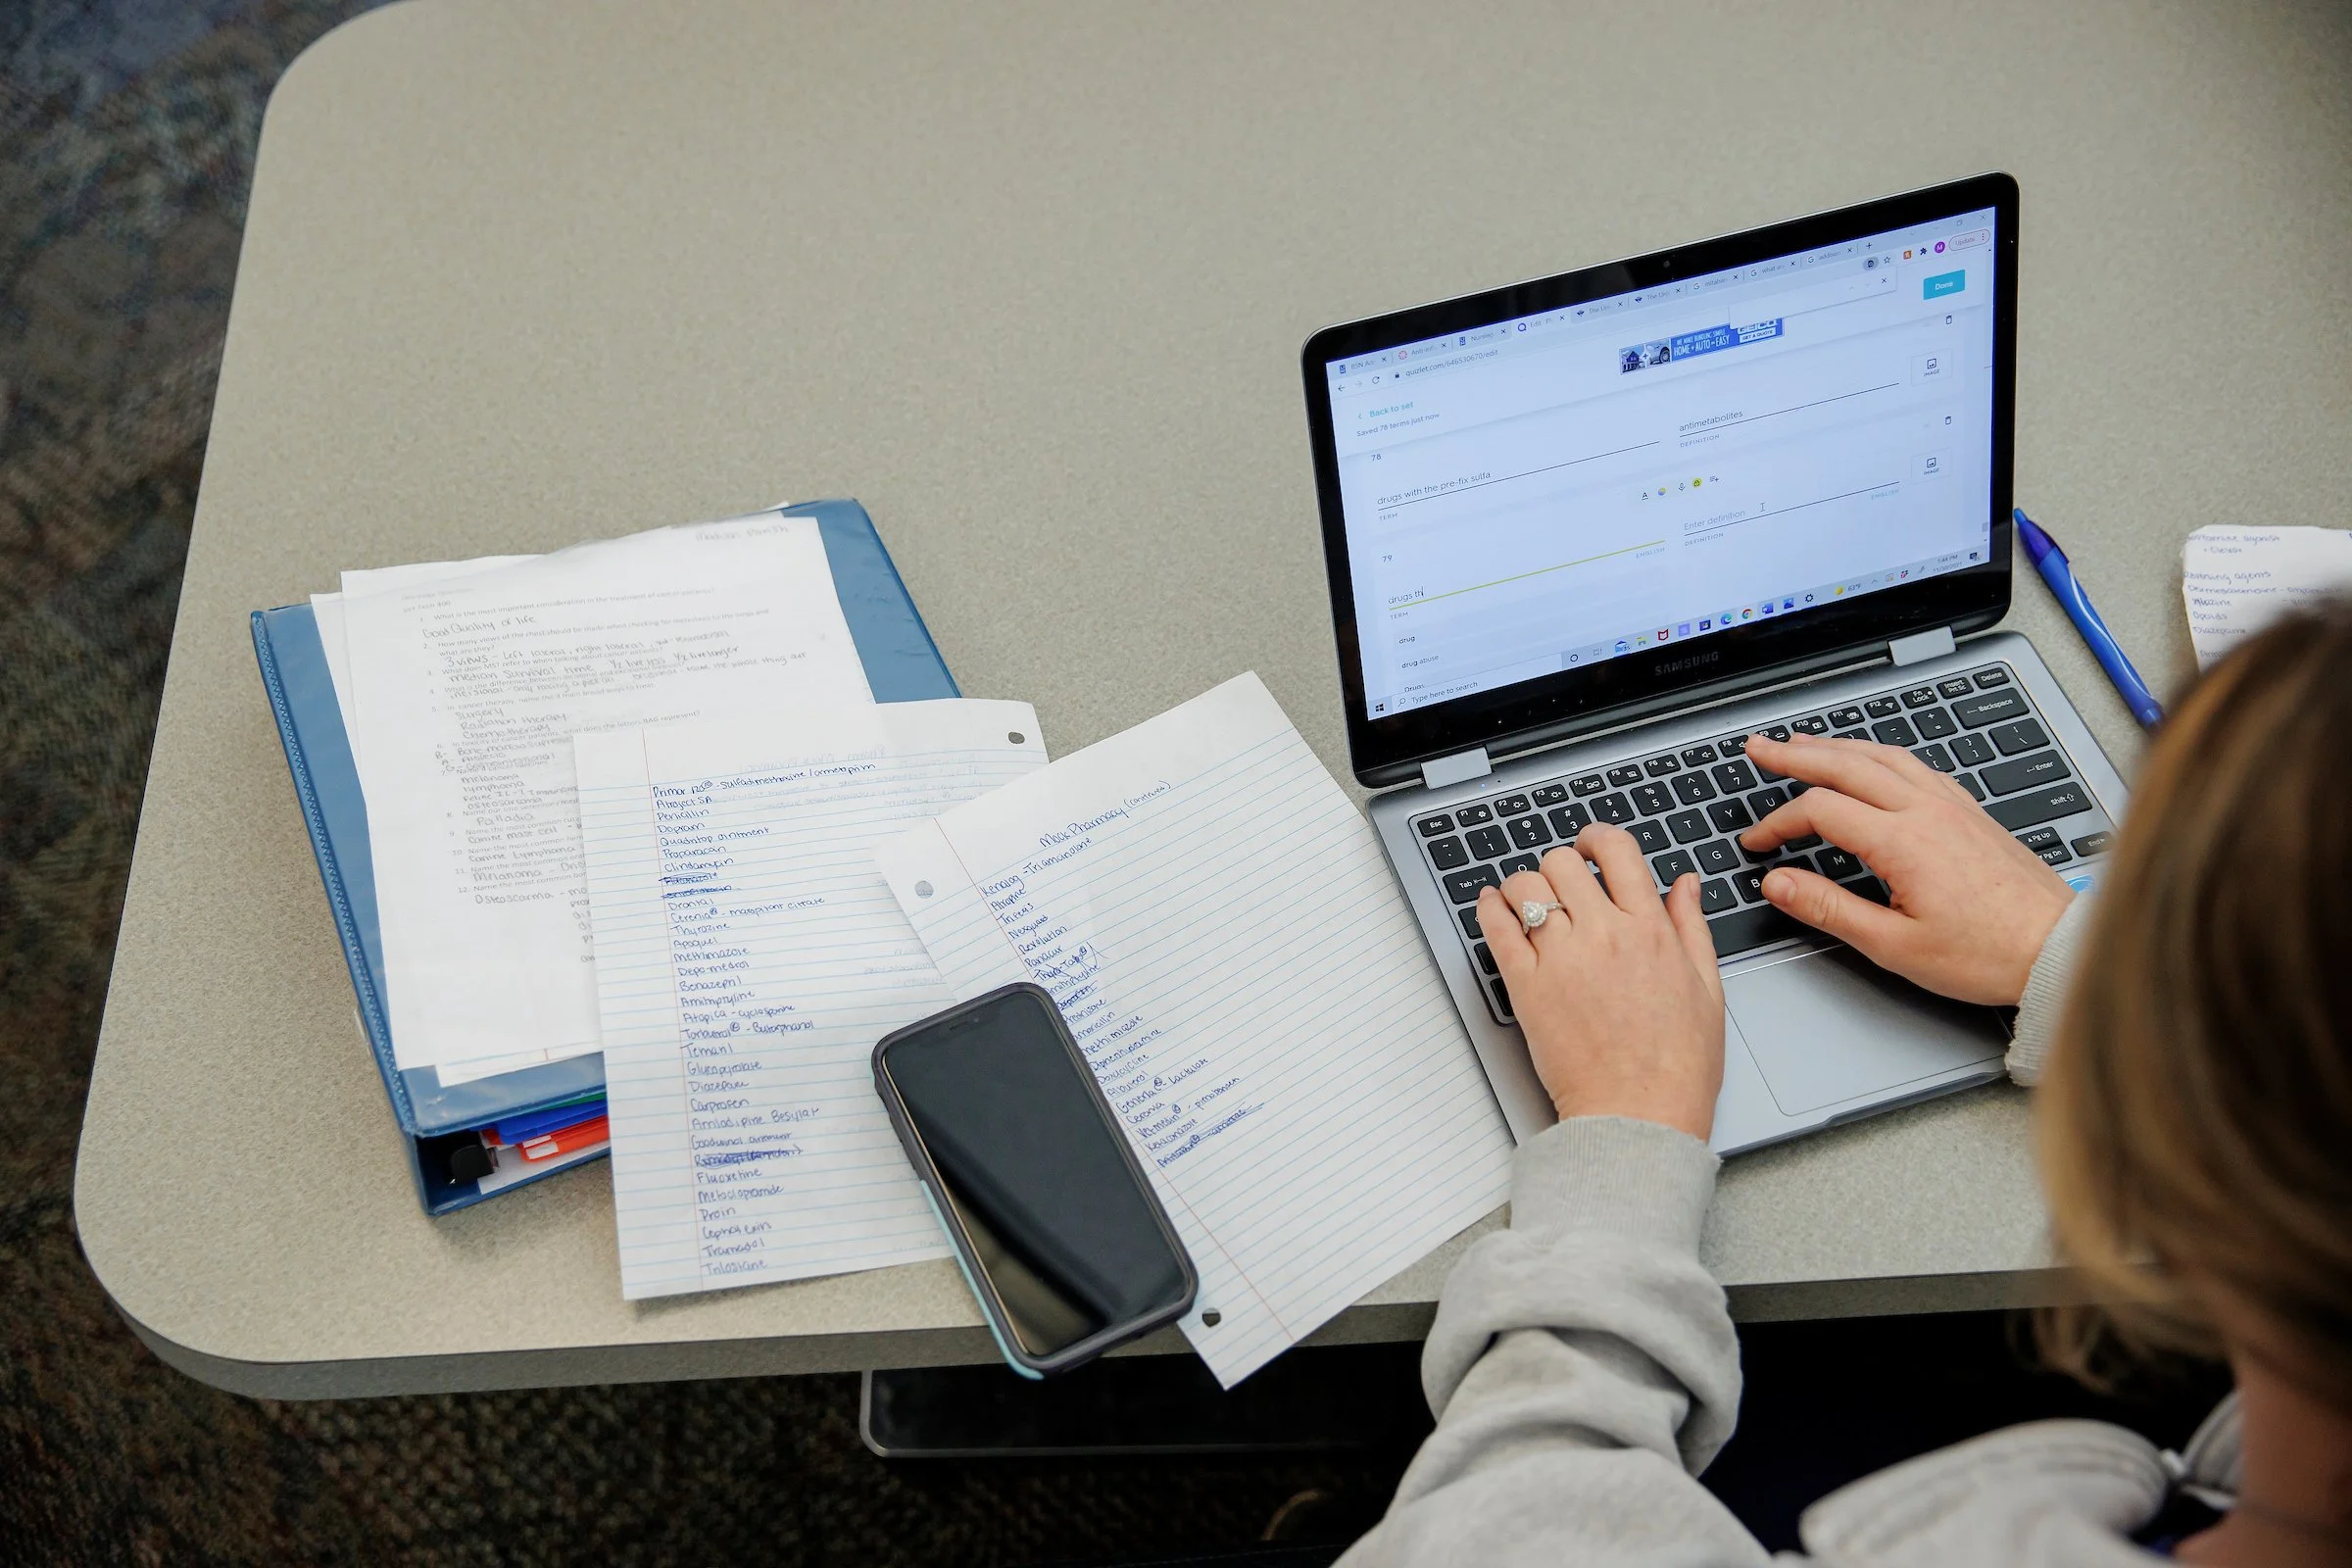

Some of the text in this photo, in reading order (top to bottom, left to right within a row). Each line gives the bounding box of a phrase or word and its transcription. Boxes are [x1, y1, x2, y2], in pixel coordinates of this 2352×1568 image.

[1935, 279, 1953, 290] Done
[1673, 335, 1730, 358] HOME AUTO EASY
[1369, 402, 1414, 418] Back to set
[1356, 425, 1379, 437] Saved
[1390, 420, 1410, 430] terms
[1410, 416, 1424, 428] just
[1425, 413, 1440, 421] now
[1679, 410, 1743, 432] antimetabolites
[1680, 434, 1720, 448] DEFINITION
[1923, 466, 1939, 475] IMAGE
[1377, 470, 1491, 506] drugs with the pre-fix sulfa
[1379, 513, 1397, 521] TERM
[1685, 509, 1745, 532] Enter definition
[1685, 532, 1724, 546] DEFINITION
[1636, 547, 1665, 559] ENGLISH
[1382, 554, 1393, 563] 79
[1388, 592, 1412, 605] drugs
[1390, 612, 1408, 620] TERM
[1398, 635, 1415, 645] drug
[1401, 655, 1440, 669] drug abuse
[1654, 651, 1719, 676] SAMSUNG
[1981, 671, 2003, 682] Delete
[1944, 679, 1964, 688] Insert
[1412, 694, 1428, 704] Type
[1429, 689, 1446, 699] here
[1455, 681, 1478, 692] search
[1912, 694, 1930, 704] Lock
[1868, 701, 1882, 710] F12
[1978, 698, 2014, 712] Backspace
[1832, 710, 1844, 719] F11
[1795, 719, 1809, 728] F10
[1722, 739, 1733, 749] F8
[1685, 750, 1695, 759] F7
[1647, 760, 1658, 768] F6
[2034, 760, 2054, 771] Enter
[1611, 769, 1621, 778] F5
[1573, 778, 1584, 788] F4
[1734, 777, 1741, 787] 7
[1535, 789, 1545, 798] F3
[1692, 787, 1700, 797] 6
[698, 795, 712, 806] SA
[1497, 799, 1508, 808] F2
[1652, 798, 1660, 808] 5
[1766, 798, 1776, 808] U
[2050, 795, 2067, 806] Shift
[658, 808, 710, 821] Penicillin
[1459, 808, 1469, 818] F1
[1611, 809, 1619, 818] 4
[1725, 808, 1734, 818] Y
[658, 821, 706, 835] Dopram
[1039, 807, 1130, 848] Mock Pharmacy
[1429, 819, 1444, 830] Esc
[1569, 820, 1578, 830] 3
[1683, 820, 1692, 829] T
[1528, 831, 1537, 841] 2
[1642, 831, 1652, 841] R
[1488, 843, 1494, 852] 1
[1711, 850, 1722, 860] G
[1834, 855, 1845, 865] M
[663, 857, 734, 873] Clindamycin
[1670, 861, 1680, 871] F
[1458, 879, 1473, 889] Tab
[1708, 890, 1718, 900] V
[787, 897, 825, 909] citrate
[673, 936, 718, 949] Apoquel
[1017, 923, 1068, 955] Revolution
[1024, 944, 1063, 968] Panacur
[690, 1098, 750, 1114] Carprofen
[692, 1113, 765, 1131] Amlodipine
[697, 1167, 762, 1185] Fluoxetine
[699, 1206, 737, 1223] Proin
[703, 1221, 771, 1241] Cephalexin
[702, 1237, 765, 1258] Tramadol
